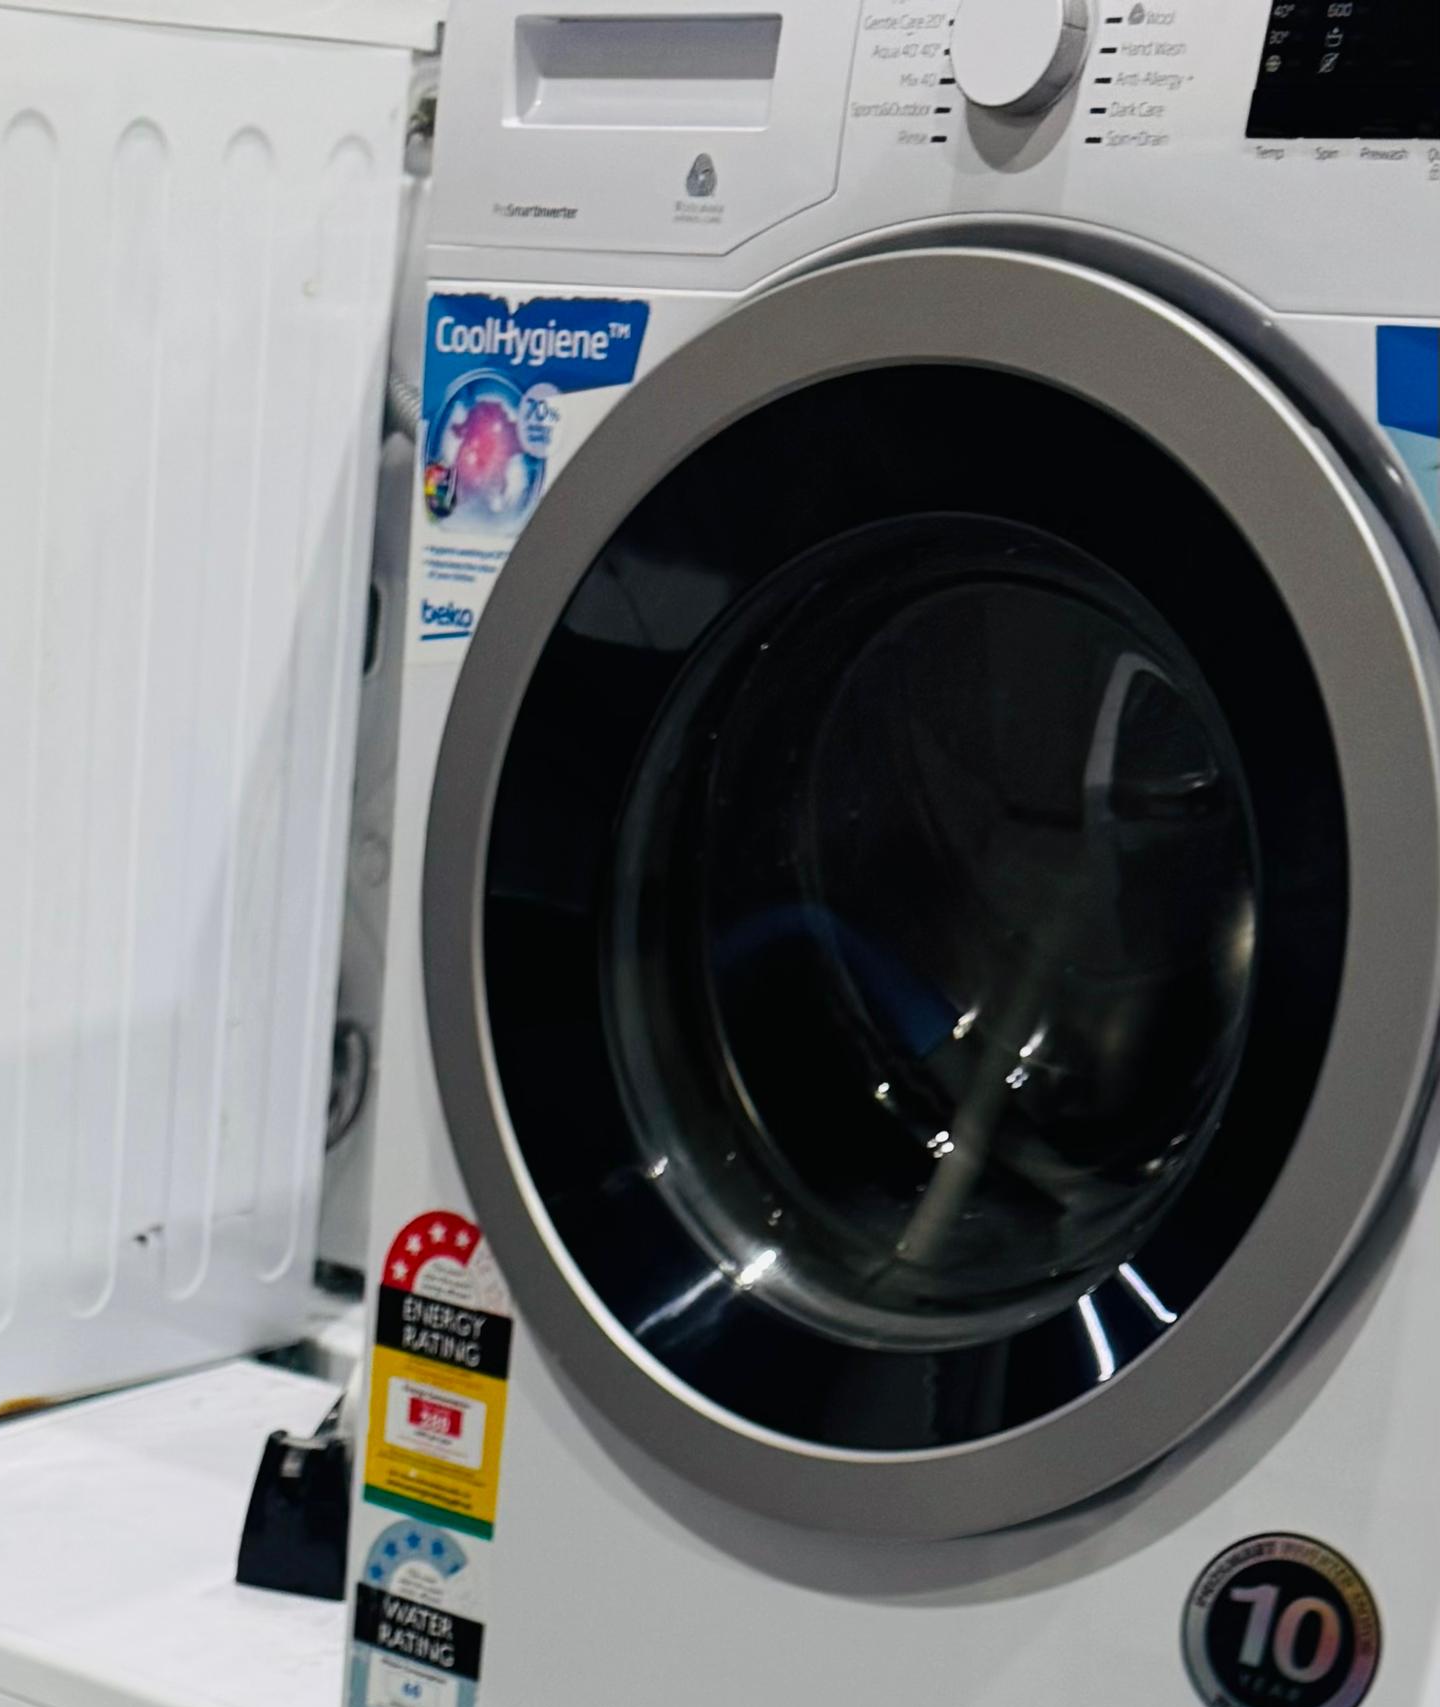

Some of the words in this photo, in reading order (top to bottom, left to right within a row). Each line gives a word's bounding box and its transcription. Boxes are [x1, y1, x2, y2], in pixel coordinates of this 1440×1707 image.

[421, 600, 473, 629] beko
[401, 1297, 488, 1341] ENERGY
[401, 1323, 481, 1369] RATING
[382, 1596, 454, 1639] WATER
[1229, 1583, 1342, 1685] 10
[377, 1622, 456, 1668] RATING
